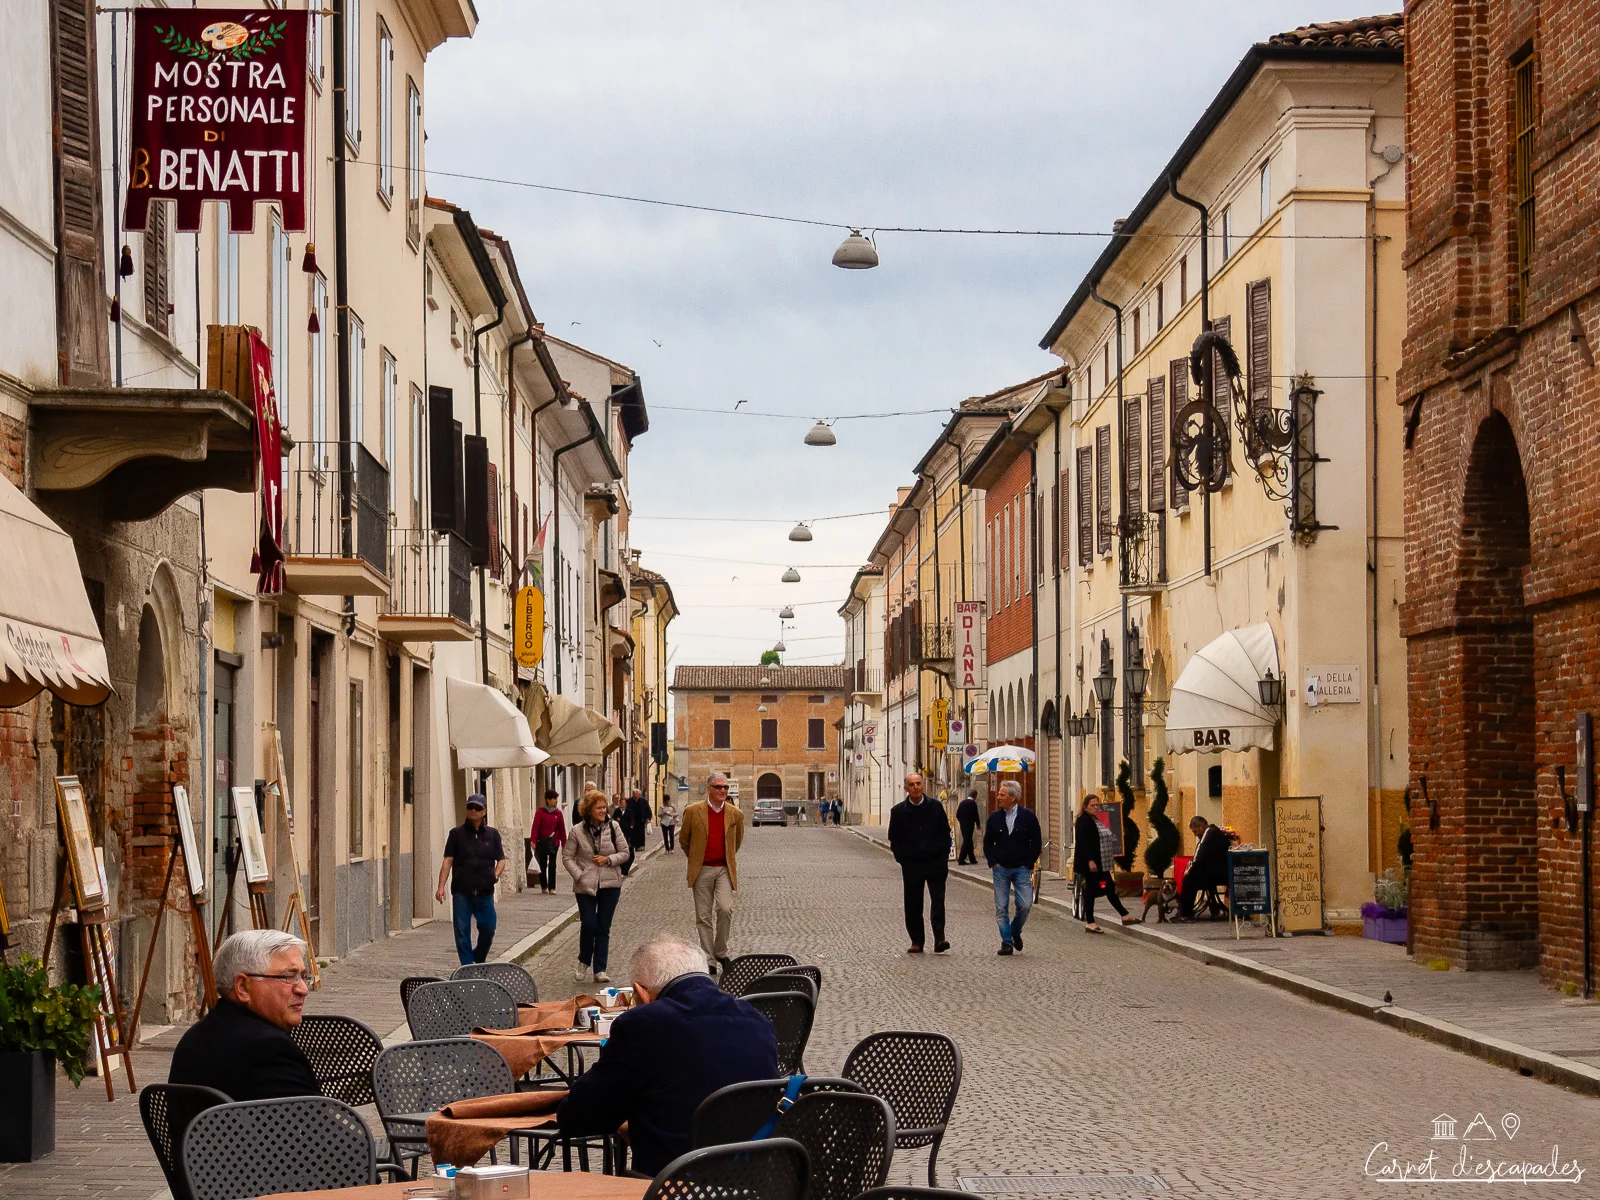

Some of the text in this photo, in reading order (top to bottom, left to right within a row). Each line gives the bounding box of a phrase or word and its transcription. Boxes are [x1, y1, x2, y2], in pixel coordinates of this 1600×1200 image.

[154, 61, 287, 89] MOSTRA
[147, 94, 296, 124] PERSONALE
[204, 130, 225, 142] DI
[158, 148, 299, 193] BENATTI
[956, 603, 978, 613] BAR
[524, 588, 534, 649] ALBERGO
[962, 615, 975, 686] DIANA
[1326, 672, 1353, 683] DELLA
[1314, 685, 1352, 696] ALLERIA
[1193, 729, 1231, 746] BAR
[1277, 834, 1307, 846] Ducale
